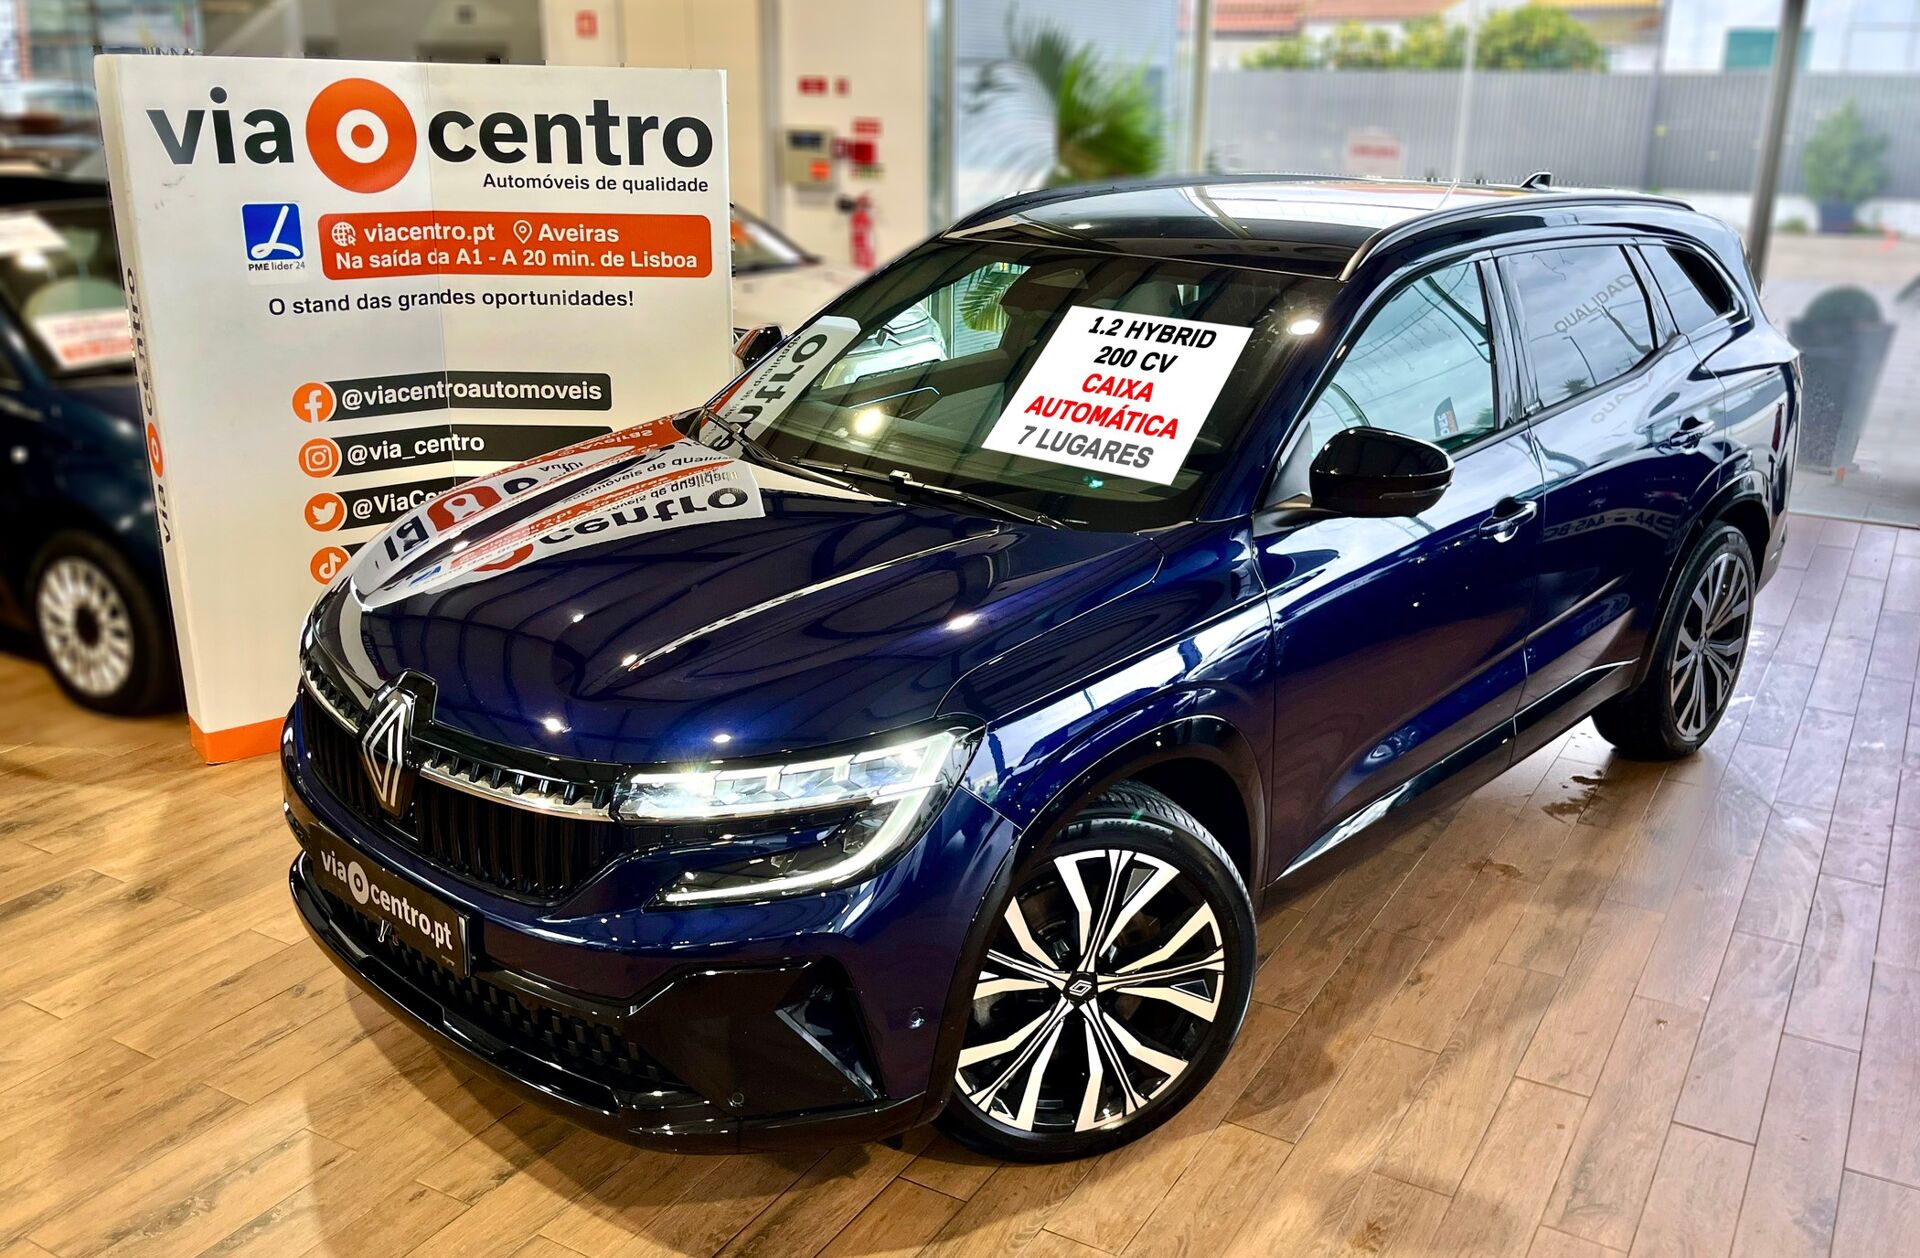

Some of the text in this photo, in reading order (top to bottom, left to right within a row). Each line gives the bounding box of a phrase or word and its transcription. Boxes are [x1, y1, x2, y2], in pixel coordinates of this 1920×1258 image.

[147, 86, 714, 169] via centro
[483, 174, 709, 194] Automóveis de qualidade
[364, 222, 620, 245] viacentro.pt Aveiras
[248, 263, 269, 271] PME
[335, 252, 363, 270] Na
[369, 248, 422, 268] saída
[427, 248, 450, 265] da
[456, 248, 483, 265] A1
[502, 249, 517, 266] A
[522, 250, 546, 266] 20
[552, 250, 595, 266] min.
[600, 250, 625, 267] de
[630, 251, 697, 268] Lisboa
[269, 289, 634, 315] O stand das grandes oportunidades!
[1553, 273, 1637, 334] QUALIDAD
[127, 268, 153, 417] centro
[1088, 316, 1217, 349] 1.2 HYBRID
[1094, 346, 1178, 373] 200 CV
[342, 380, 602, 411] @viacentroautomoveis
[1082, 373, 1155, 402] CAIXA
[1024, 396, 1179, 440] AUTOMÁTICA
[347, 433, 485, 464] @via_centro
[1017, 425, 1154, 468] 7 LUGARES
[320, 850, 454, 951] via centro.pt
